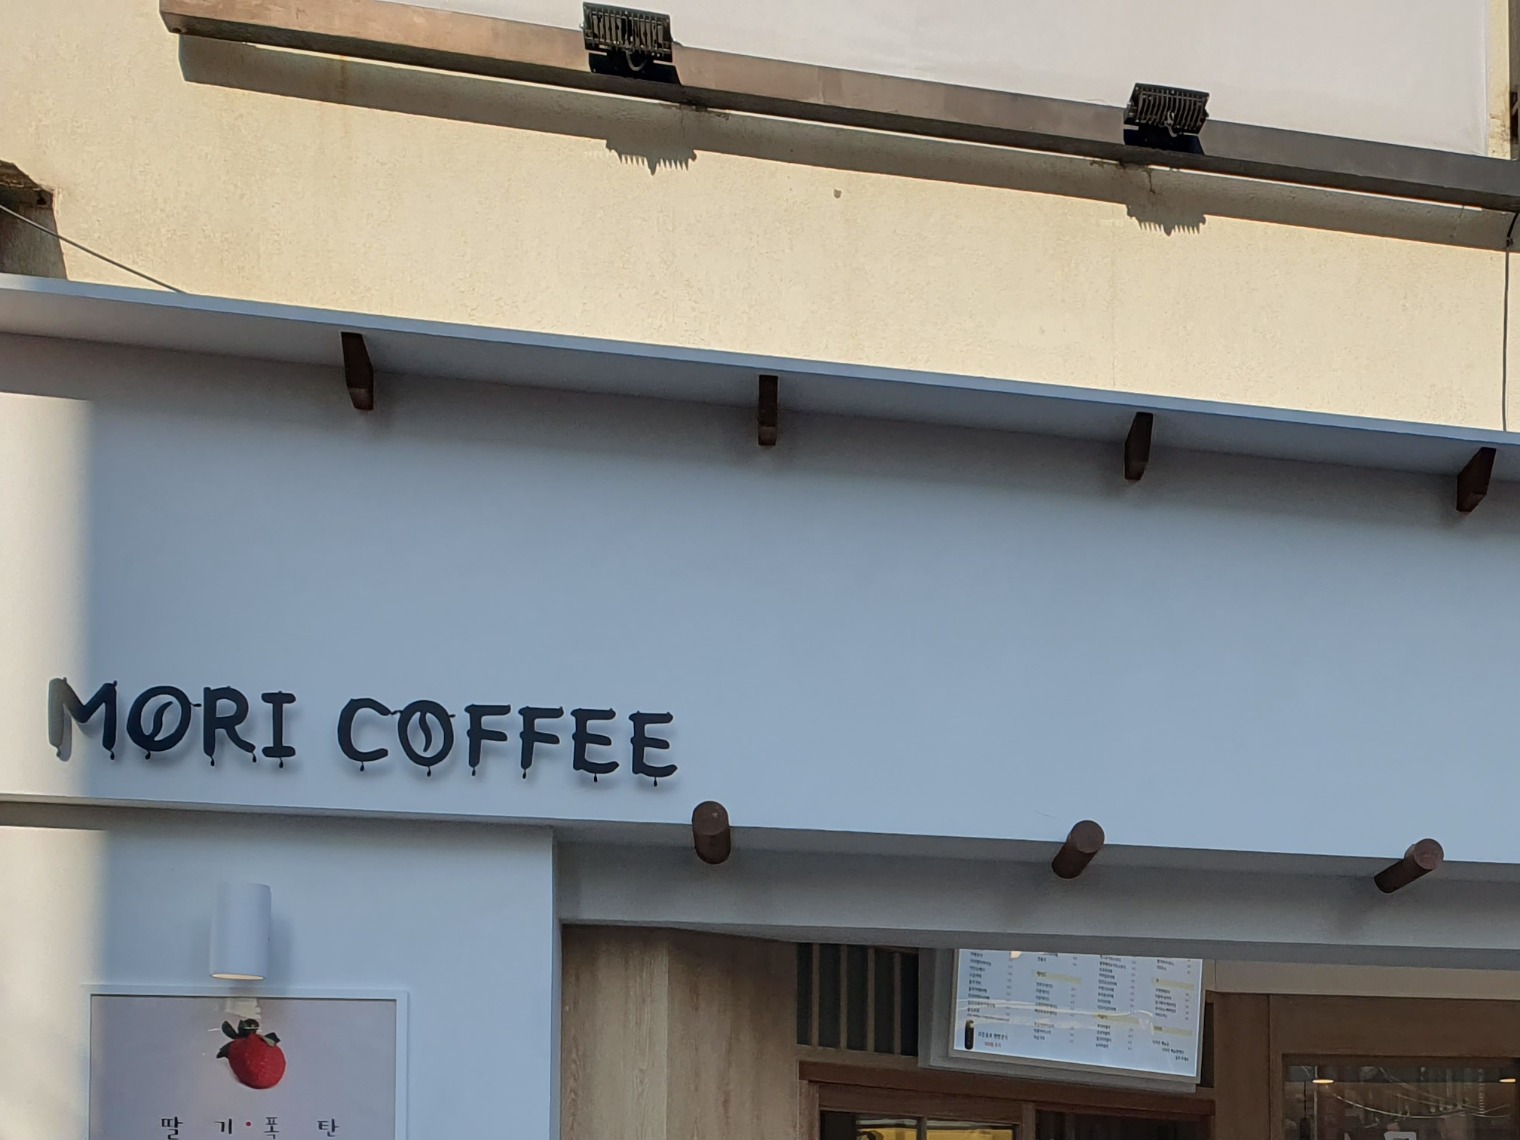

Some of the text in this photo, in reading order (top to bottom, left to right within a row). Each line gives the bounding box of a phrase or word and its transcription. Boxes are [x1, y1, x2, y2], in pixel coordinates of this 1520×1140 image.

[48, 677, 677, 786] MORI COFFEE
[161, 1116, 339, 1140] 딸기 폭탄
